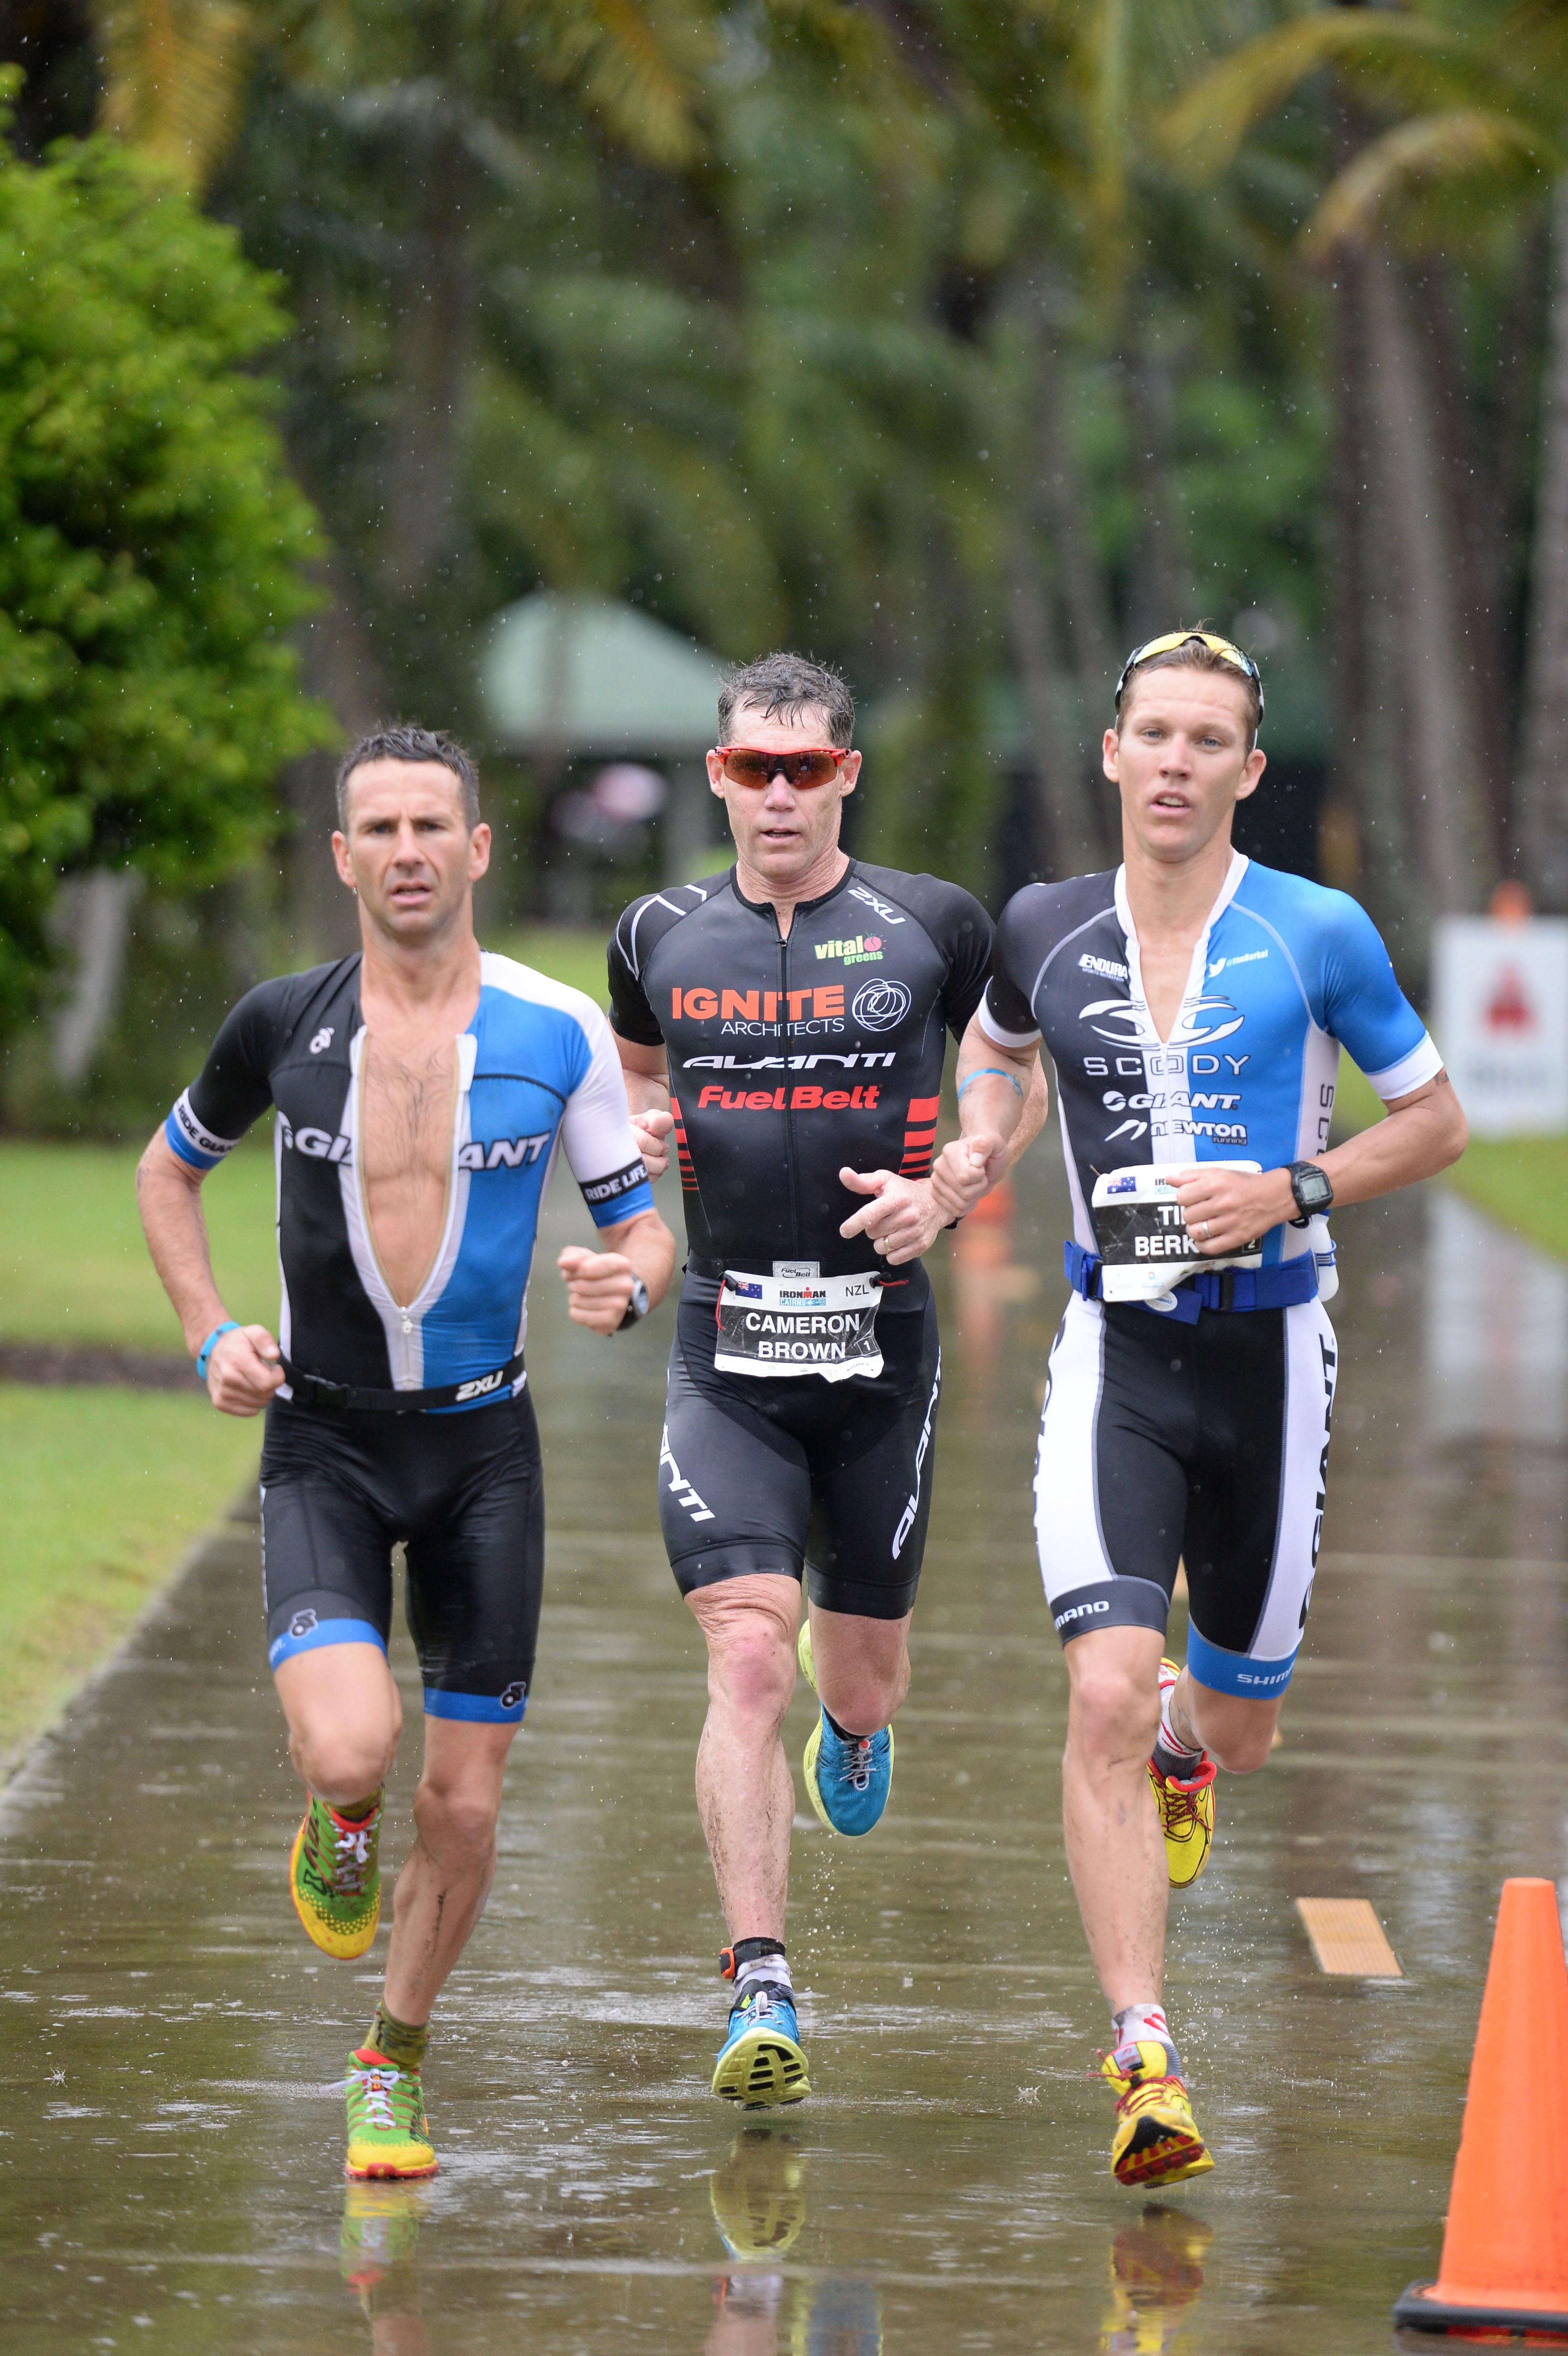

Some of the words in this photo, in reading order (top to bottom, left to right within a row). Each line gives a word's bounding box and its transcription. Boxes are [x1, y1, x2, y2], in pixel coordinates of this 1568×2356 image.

[848, 886, 906, 925] 2XU
[814, 935, 864, 960] vital
[843, 950, 883, 966] greens
[1078, 953, 1128, 980] ENDURA
[672, 985, 845, 1022] IGNITE
[721, 1018, 845, 1036] ARCHITECTS
[1083, 1054, 1251, 1075] SCODY
[1128, 1091, 1241, 1110] GIANT
[1213, 1136, 1247, 1145] running
[585, 1178, 622, 1200] RIDE
[1135, 1234, 1199, 1256] BERK
[780, 1287, 826, 1298] IRONMAN
[845, 1285, 870, 1297] NZL
[746, 1313, 860, 1334] CAMERON
[758, 1341, 846, 1360] BROWN
[863, 1341, 871, 1351] 1
[456, 1371, 503, 1402] 2XU
[1055, 1600, 1109, 1630] MANO
